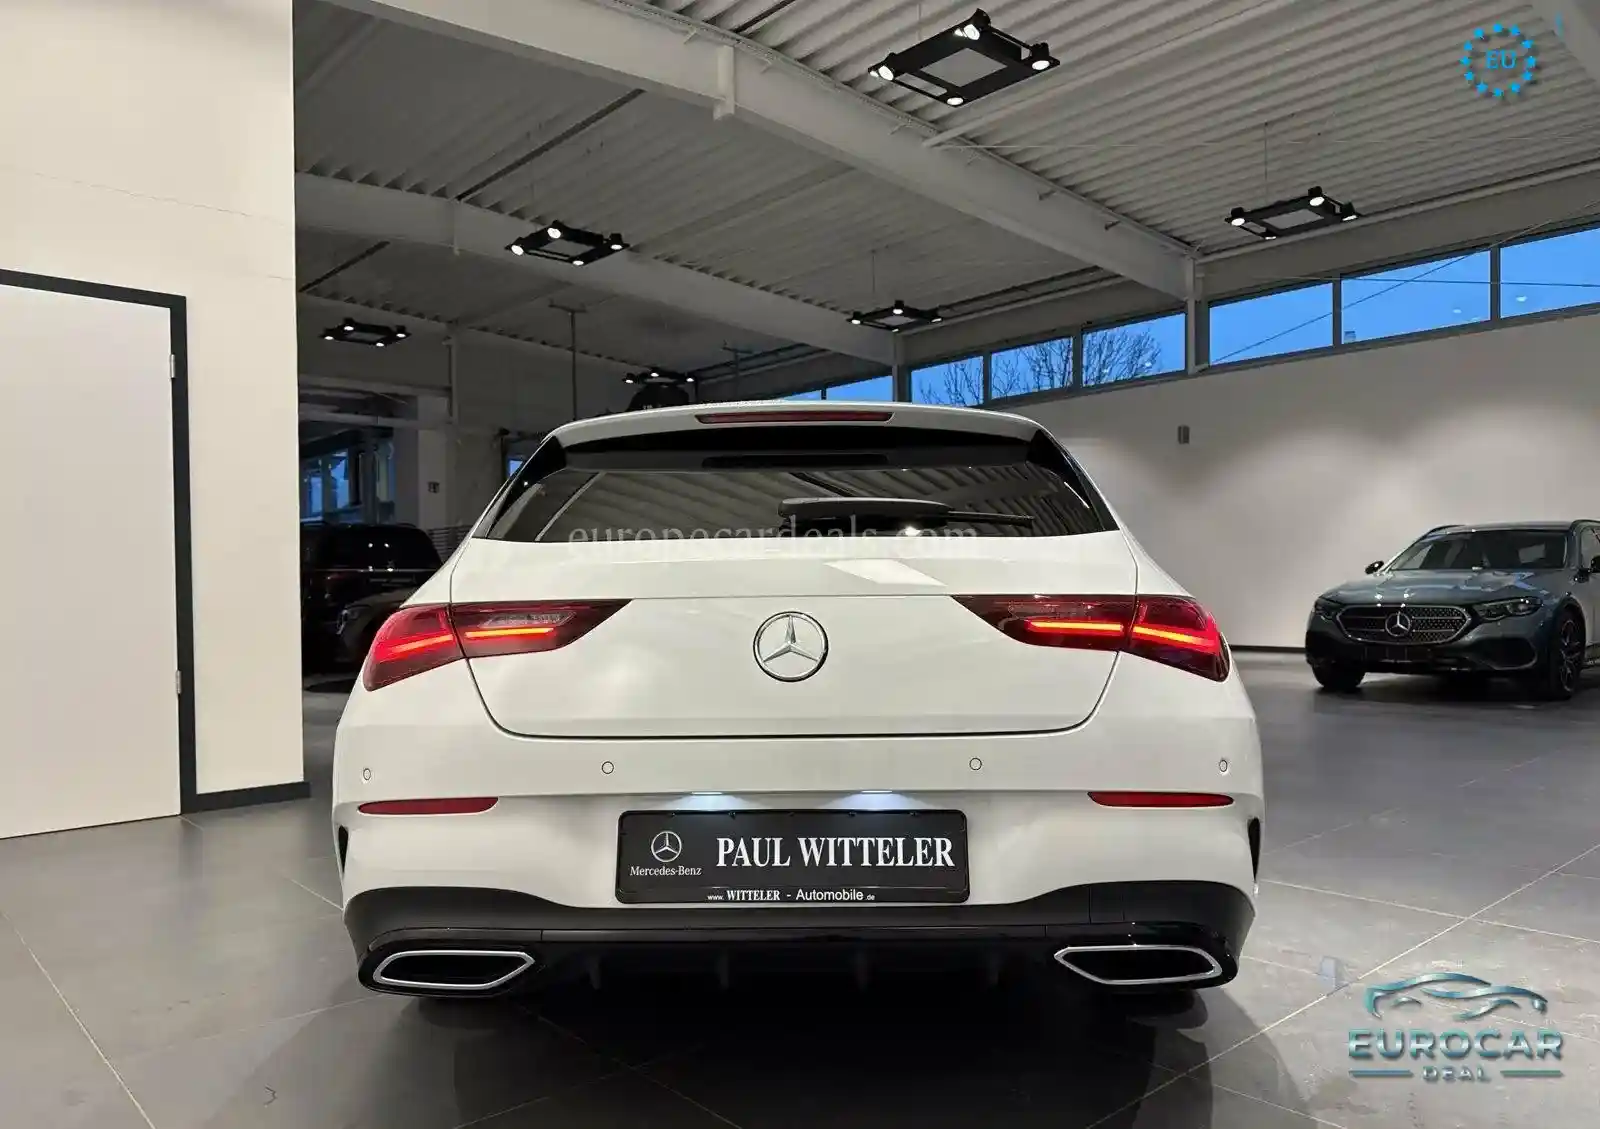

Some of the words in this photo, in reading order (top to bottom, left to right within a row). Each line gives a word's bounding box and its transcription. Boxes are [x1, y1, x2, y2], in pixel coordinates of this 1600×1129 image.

[716, 836, 791, 868] PAUL
[797, 836, 956, 868] WITTELER
[629, 865, 702, 877] Mercedes-Benz
[726, 889, 781, 901] WITTELER
[795, 888, 864, 901] Automobile
